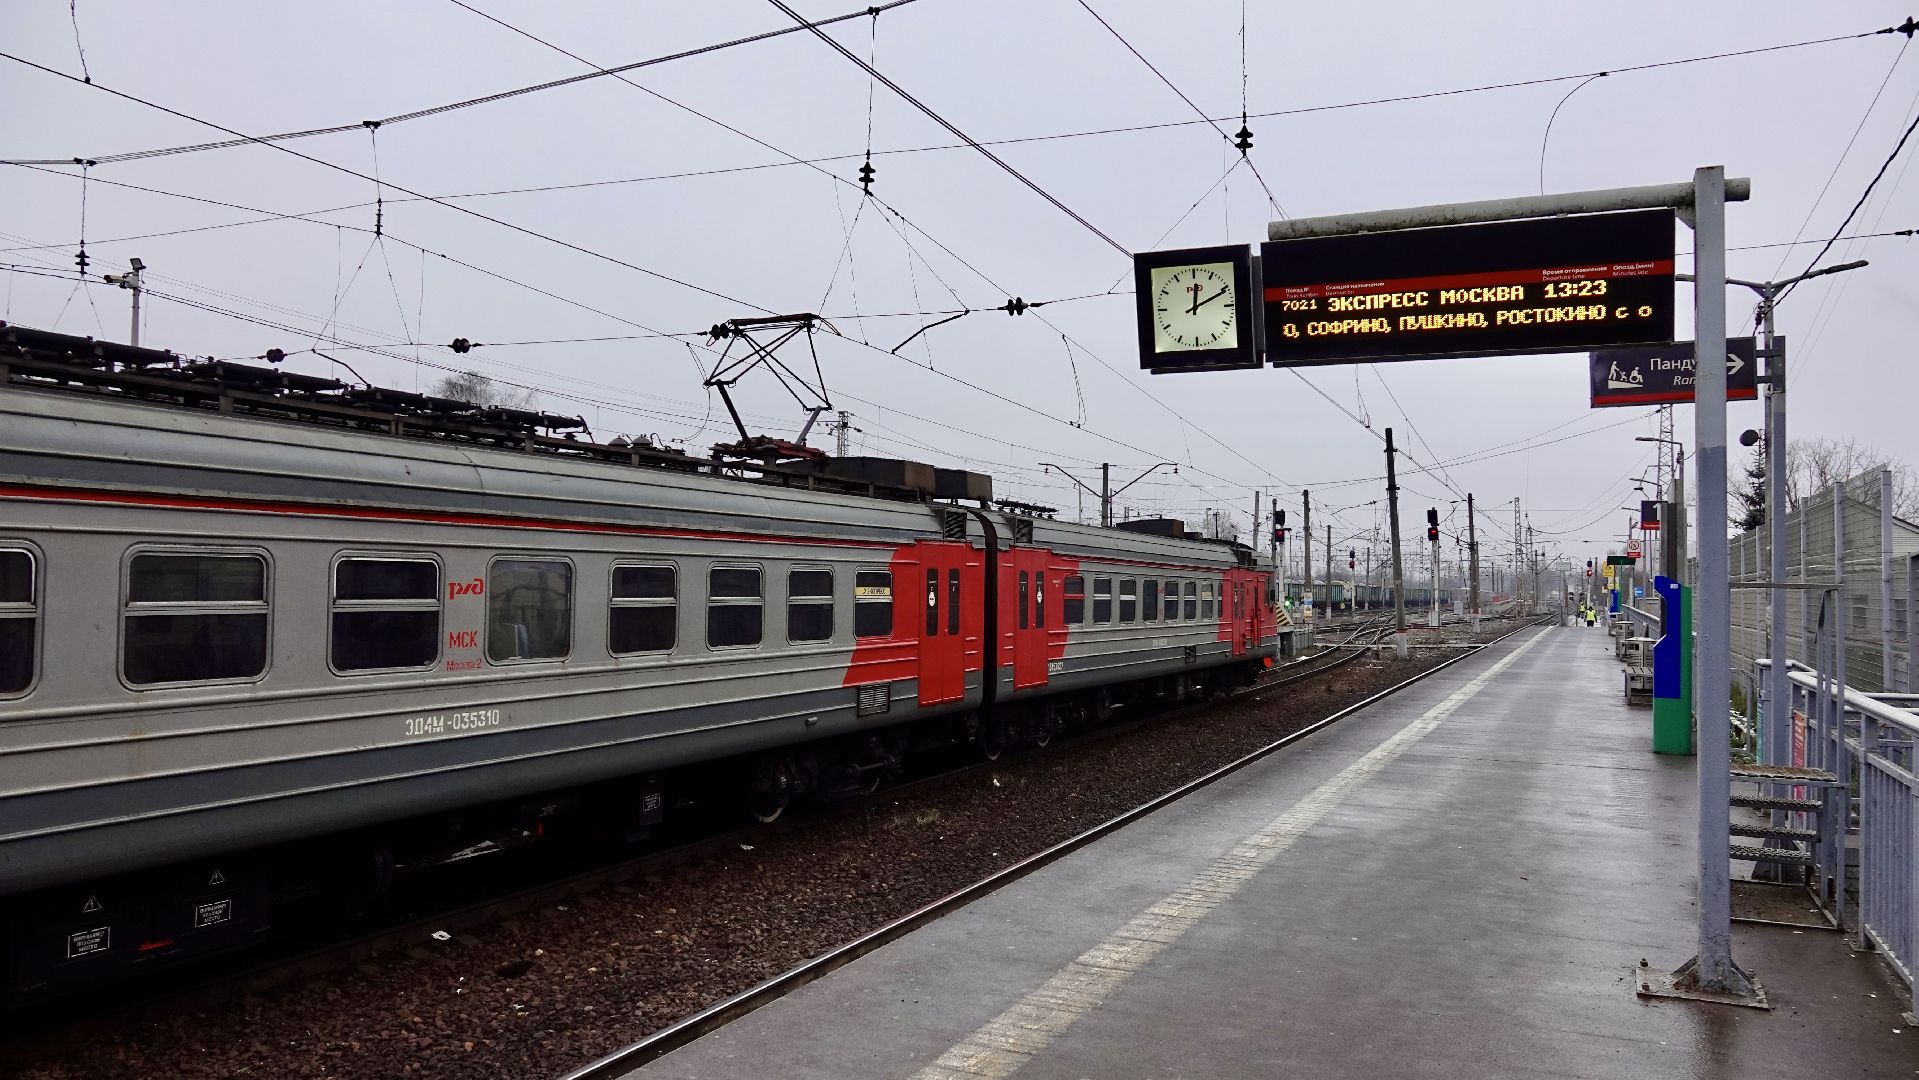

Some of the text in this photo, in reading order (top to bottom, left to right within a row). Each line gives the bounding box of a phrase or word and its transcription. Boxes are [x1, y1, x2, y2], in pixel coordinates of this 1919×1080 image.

[1328, 285, 1524, 312] ЭКСПРЕСС МОСКВА
[1544, 280, 1607, 299] 13:23
[1282, 299, 1317, 311] 7021
[1283, 323, 1300, 338] О,
[1307, 317, 1392, 336] СОФРИНО,
[1399, 312, 1489, 331] ПУШКИНО,
[1496, 304, 1607, 325] РОСТОКИНО
[449, 631, 478, 648] МСК
